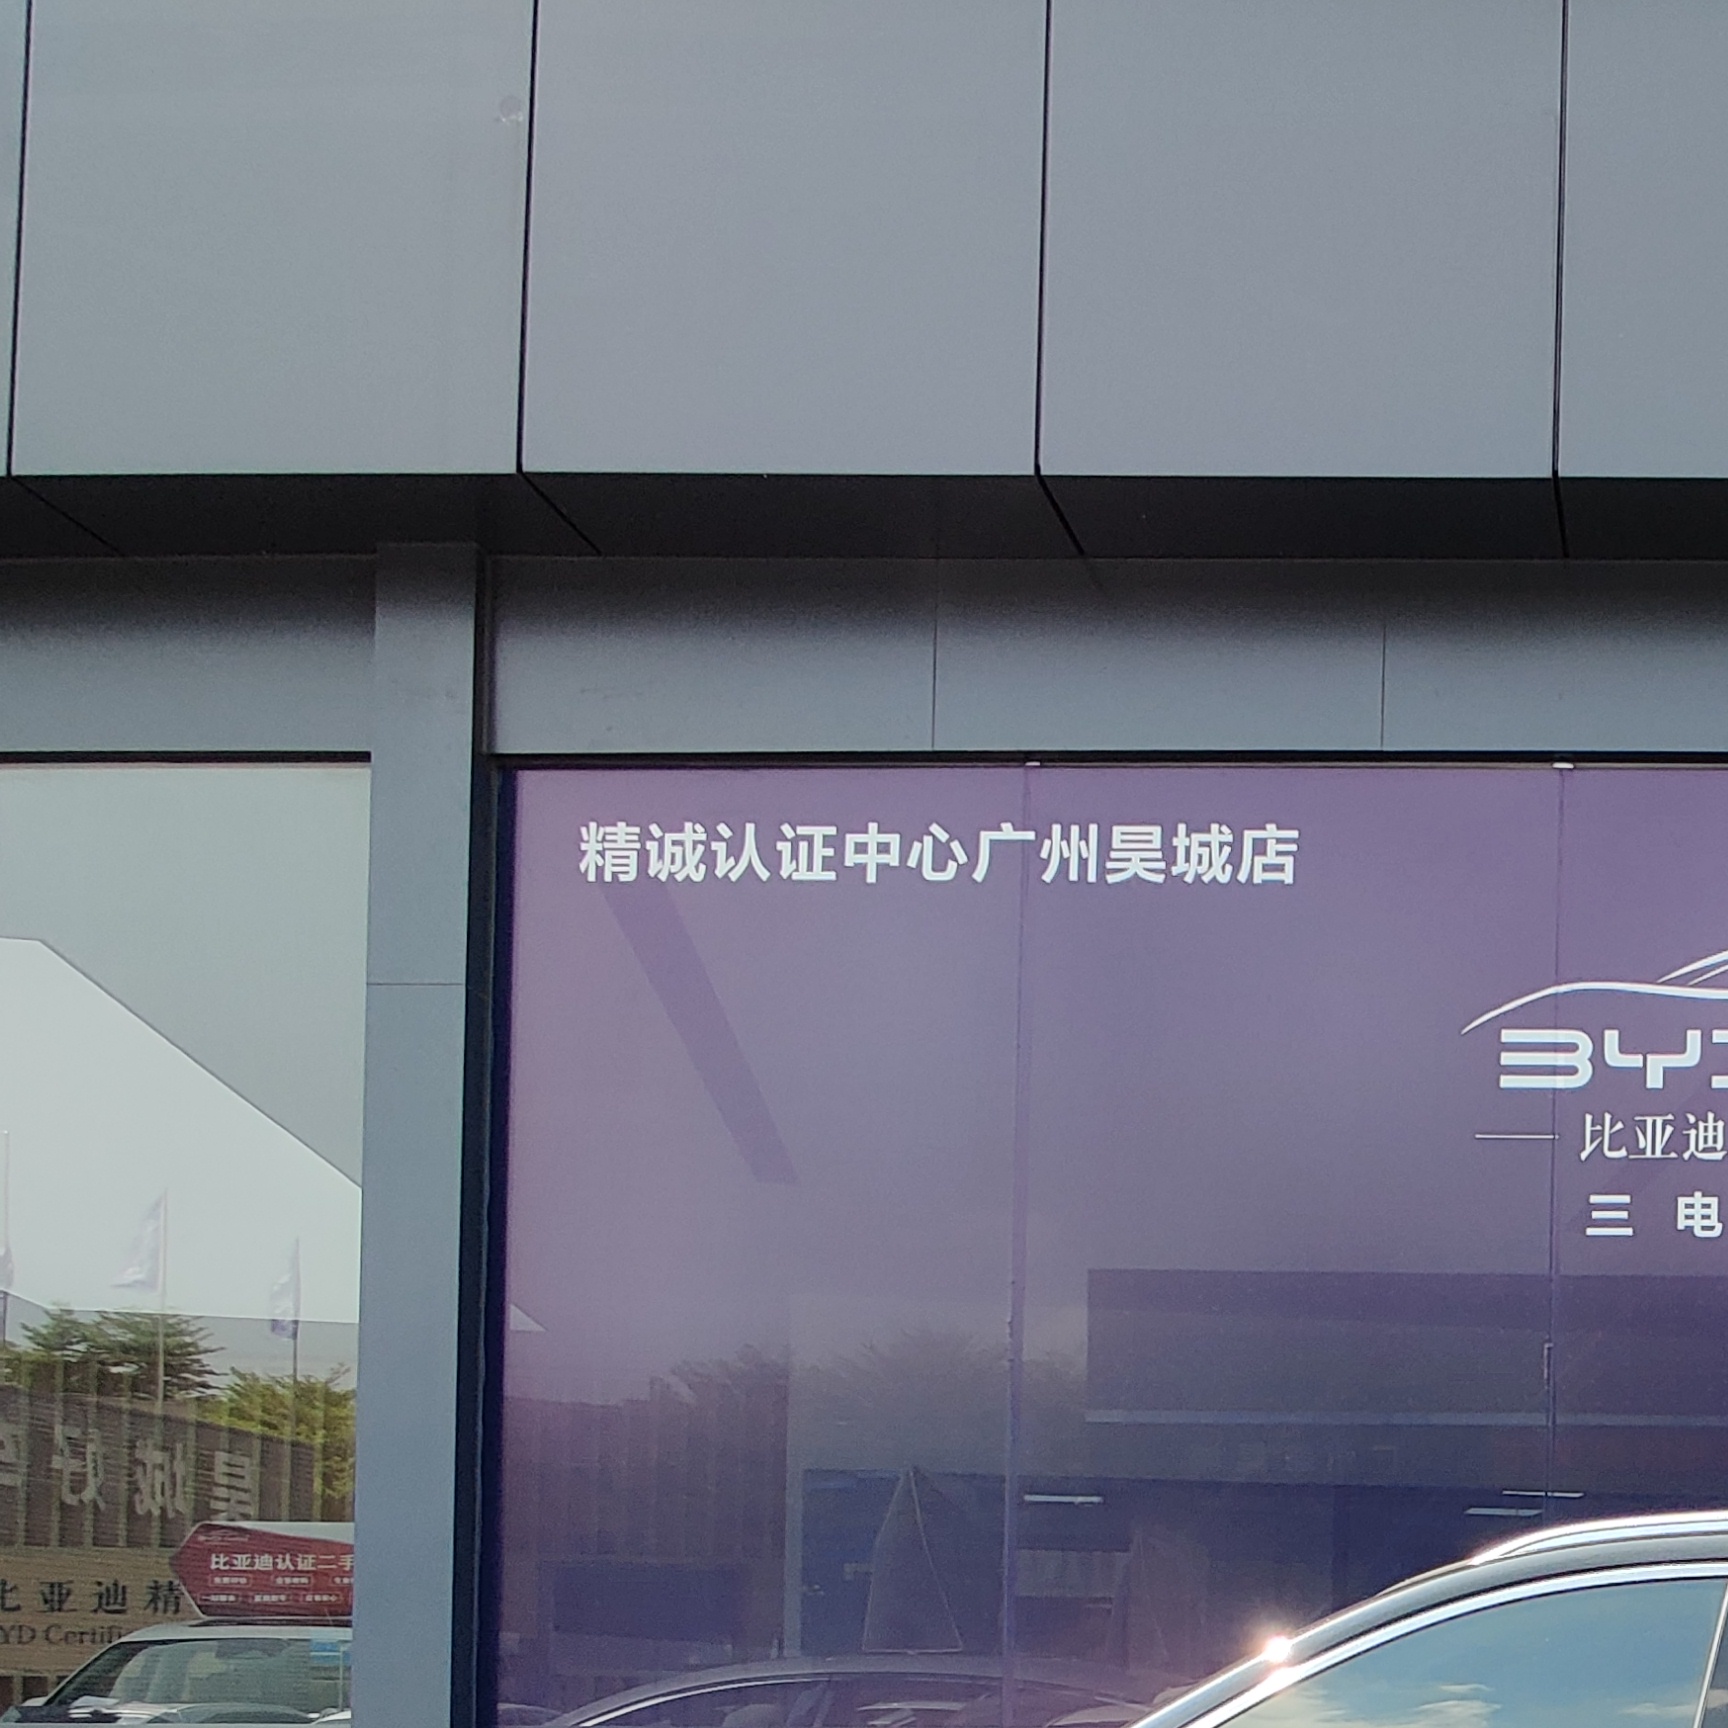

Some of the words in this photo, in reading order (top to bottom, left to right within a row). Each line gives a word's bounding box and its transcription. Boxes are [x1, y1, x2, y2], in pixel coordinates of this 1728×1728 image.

[579, 821, 1300, 886] 精诚认证中心广州昊城店
